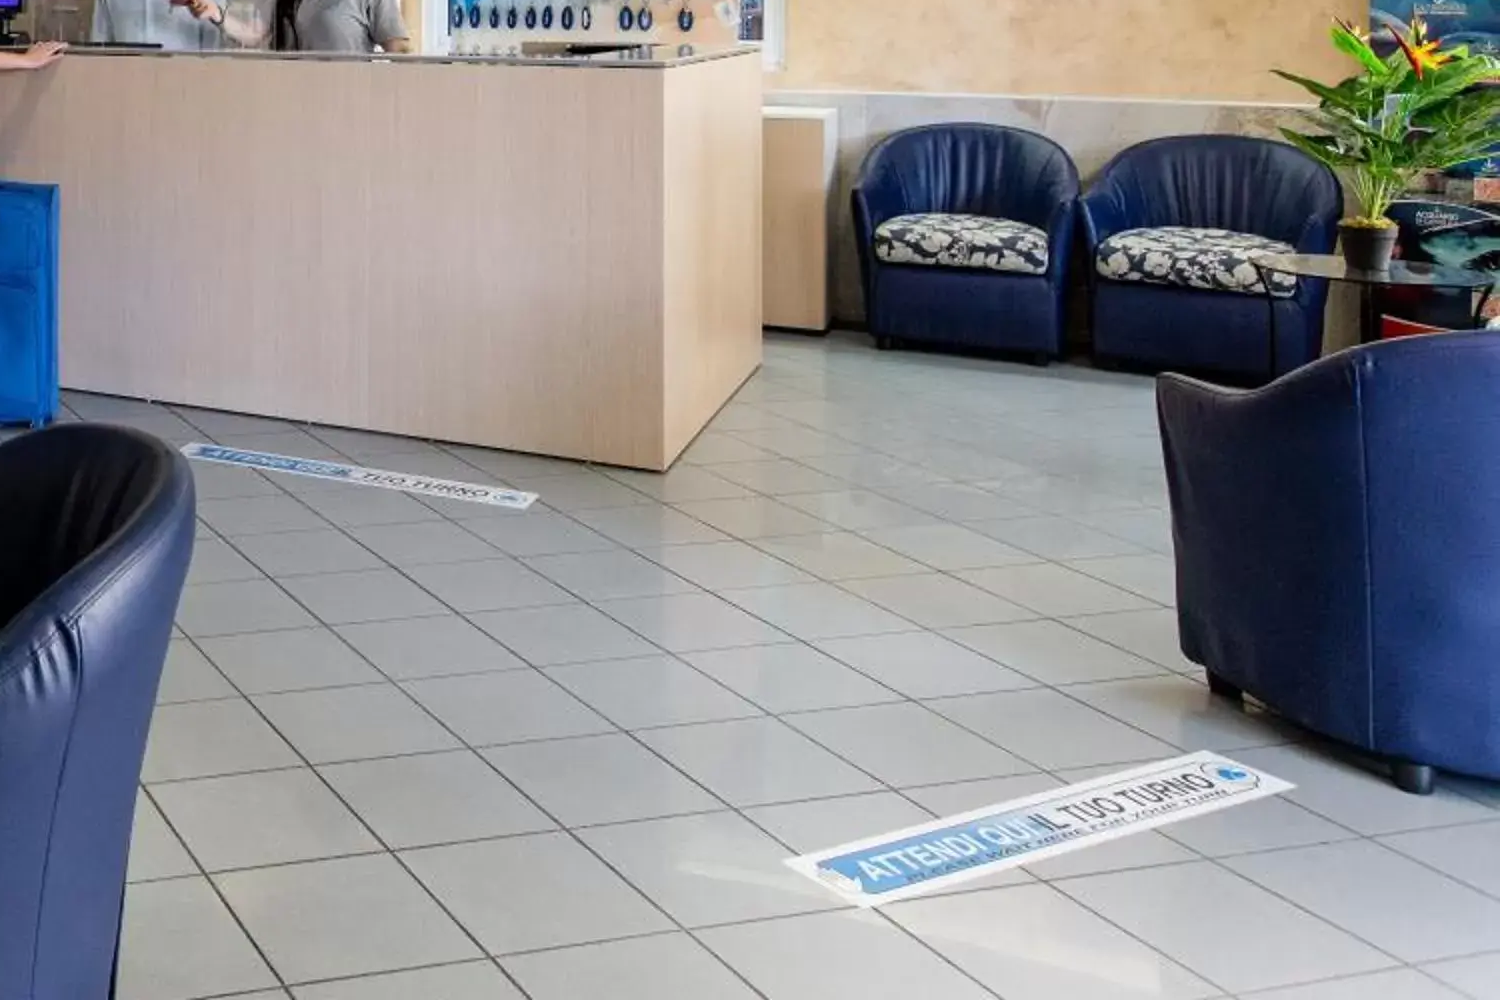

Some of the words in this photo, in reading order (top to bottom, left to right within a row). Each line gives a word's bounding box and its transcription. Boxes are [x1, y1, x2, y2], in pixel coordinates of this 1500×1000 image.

[856, 832, 988, 882] ATTENDI
[977, 817, 1041, 846] QUI
[1026, 812, 1071, 832] IL
[1055, 797, 1126, 823] TUO
[1113, 773, 1215, 807] TURNO
